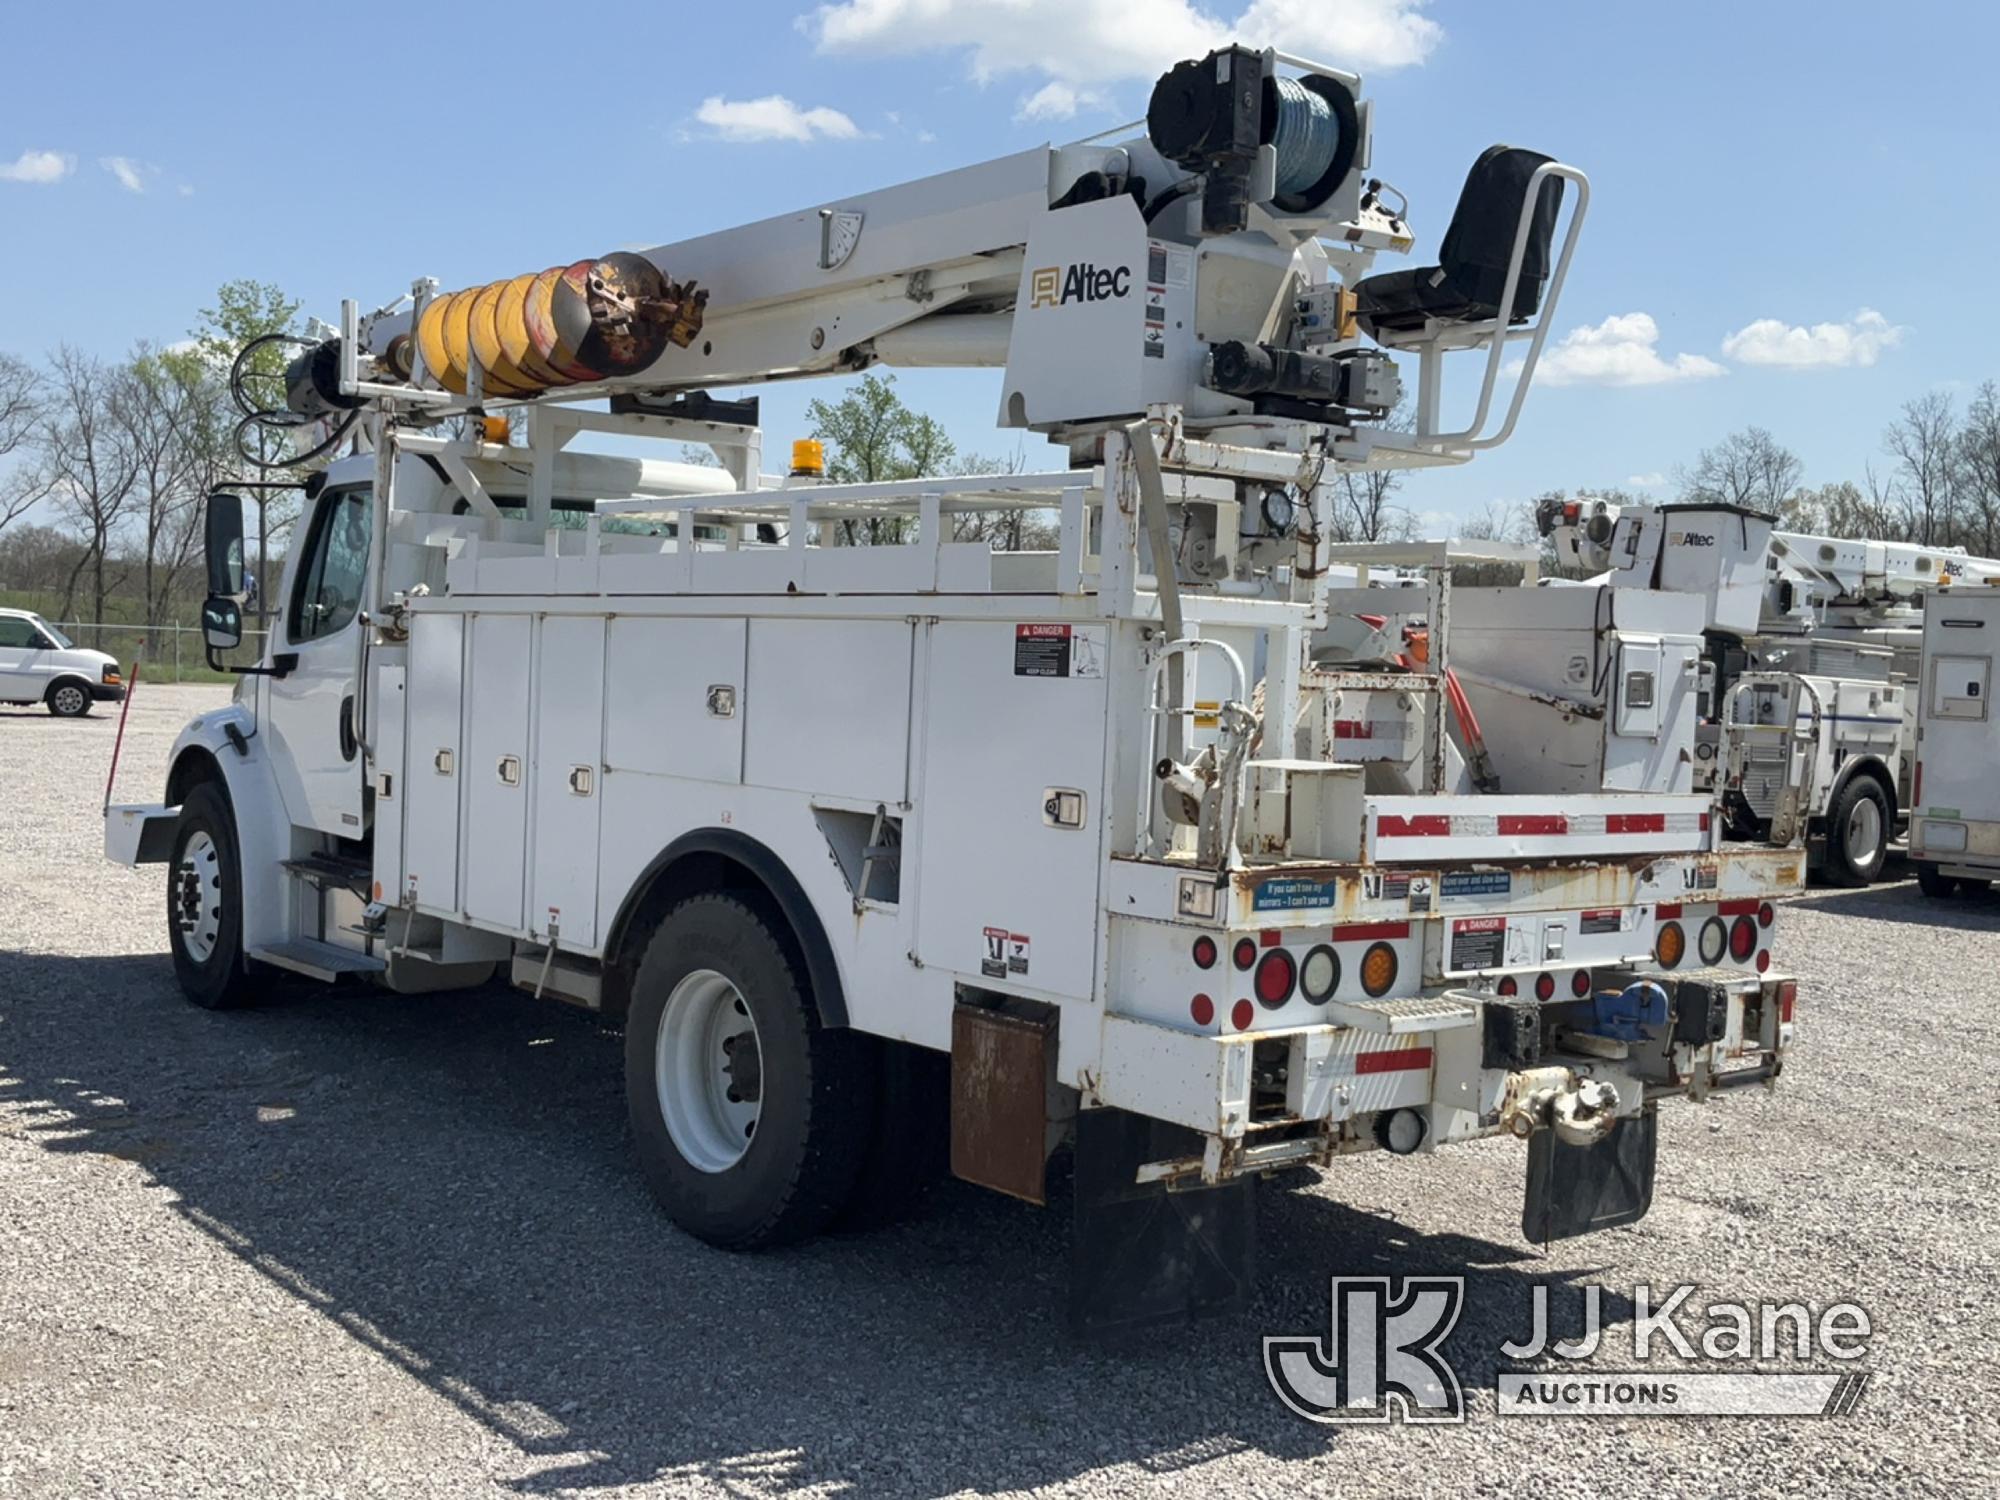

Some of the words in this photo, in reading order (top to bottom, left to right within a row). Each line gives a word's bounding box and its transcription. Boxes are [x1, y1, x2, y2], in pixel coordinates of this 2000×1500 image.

[1060, 263, 1131, 305] Altec
[1683, 532, 1714, 547] Altec
[1032, 626, 1064, 636] DANGER
[1273, 885, 1284, 895] you
[1319, 897, 1329, 906] you
[1469, 919, 1499, 929] DANGER
